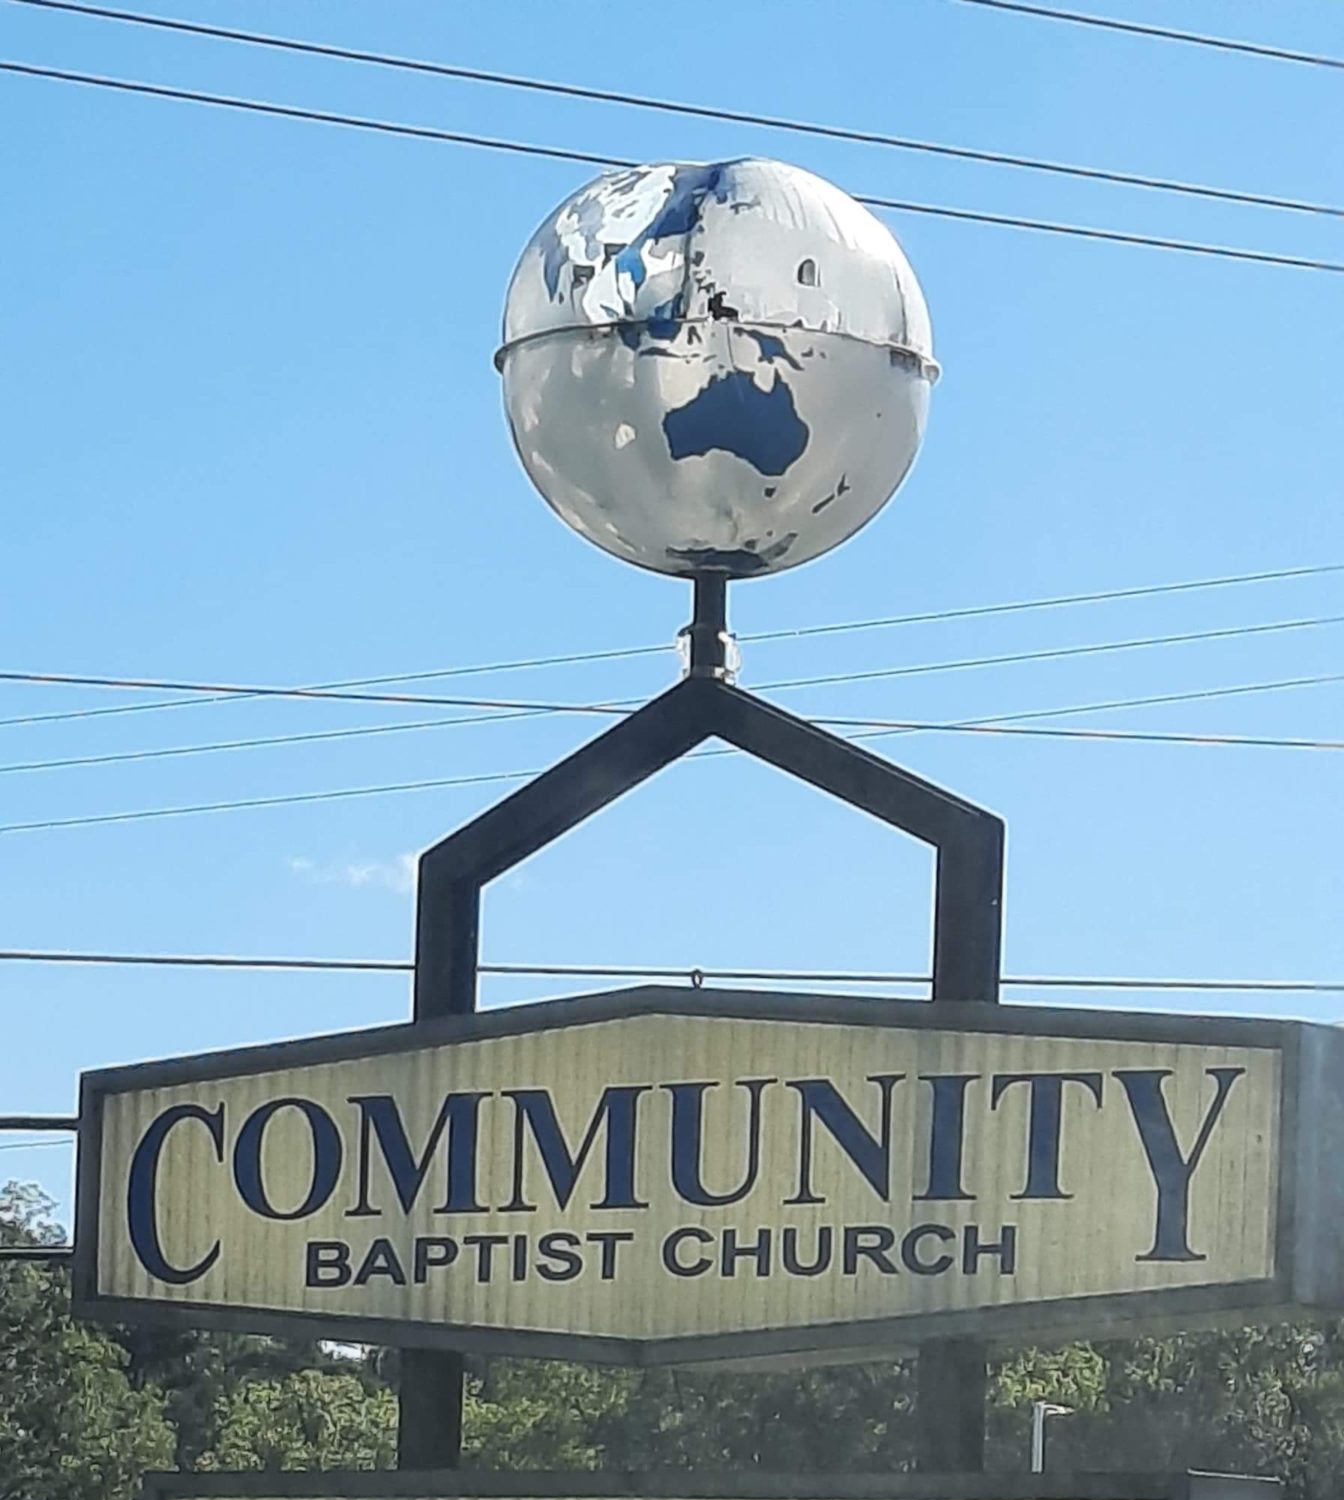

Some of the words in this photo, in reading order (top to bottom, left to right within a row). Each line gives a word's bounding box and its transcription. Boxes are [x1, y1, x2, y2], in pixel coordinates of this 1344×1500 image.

[127, 1067, 1245, 1284] COMMUNITY
[305, 1231, 633, 1288] BAPTIST
[662, 1225, 1017, 1278] CHURCH
